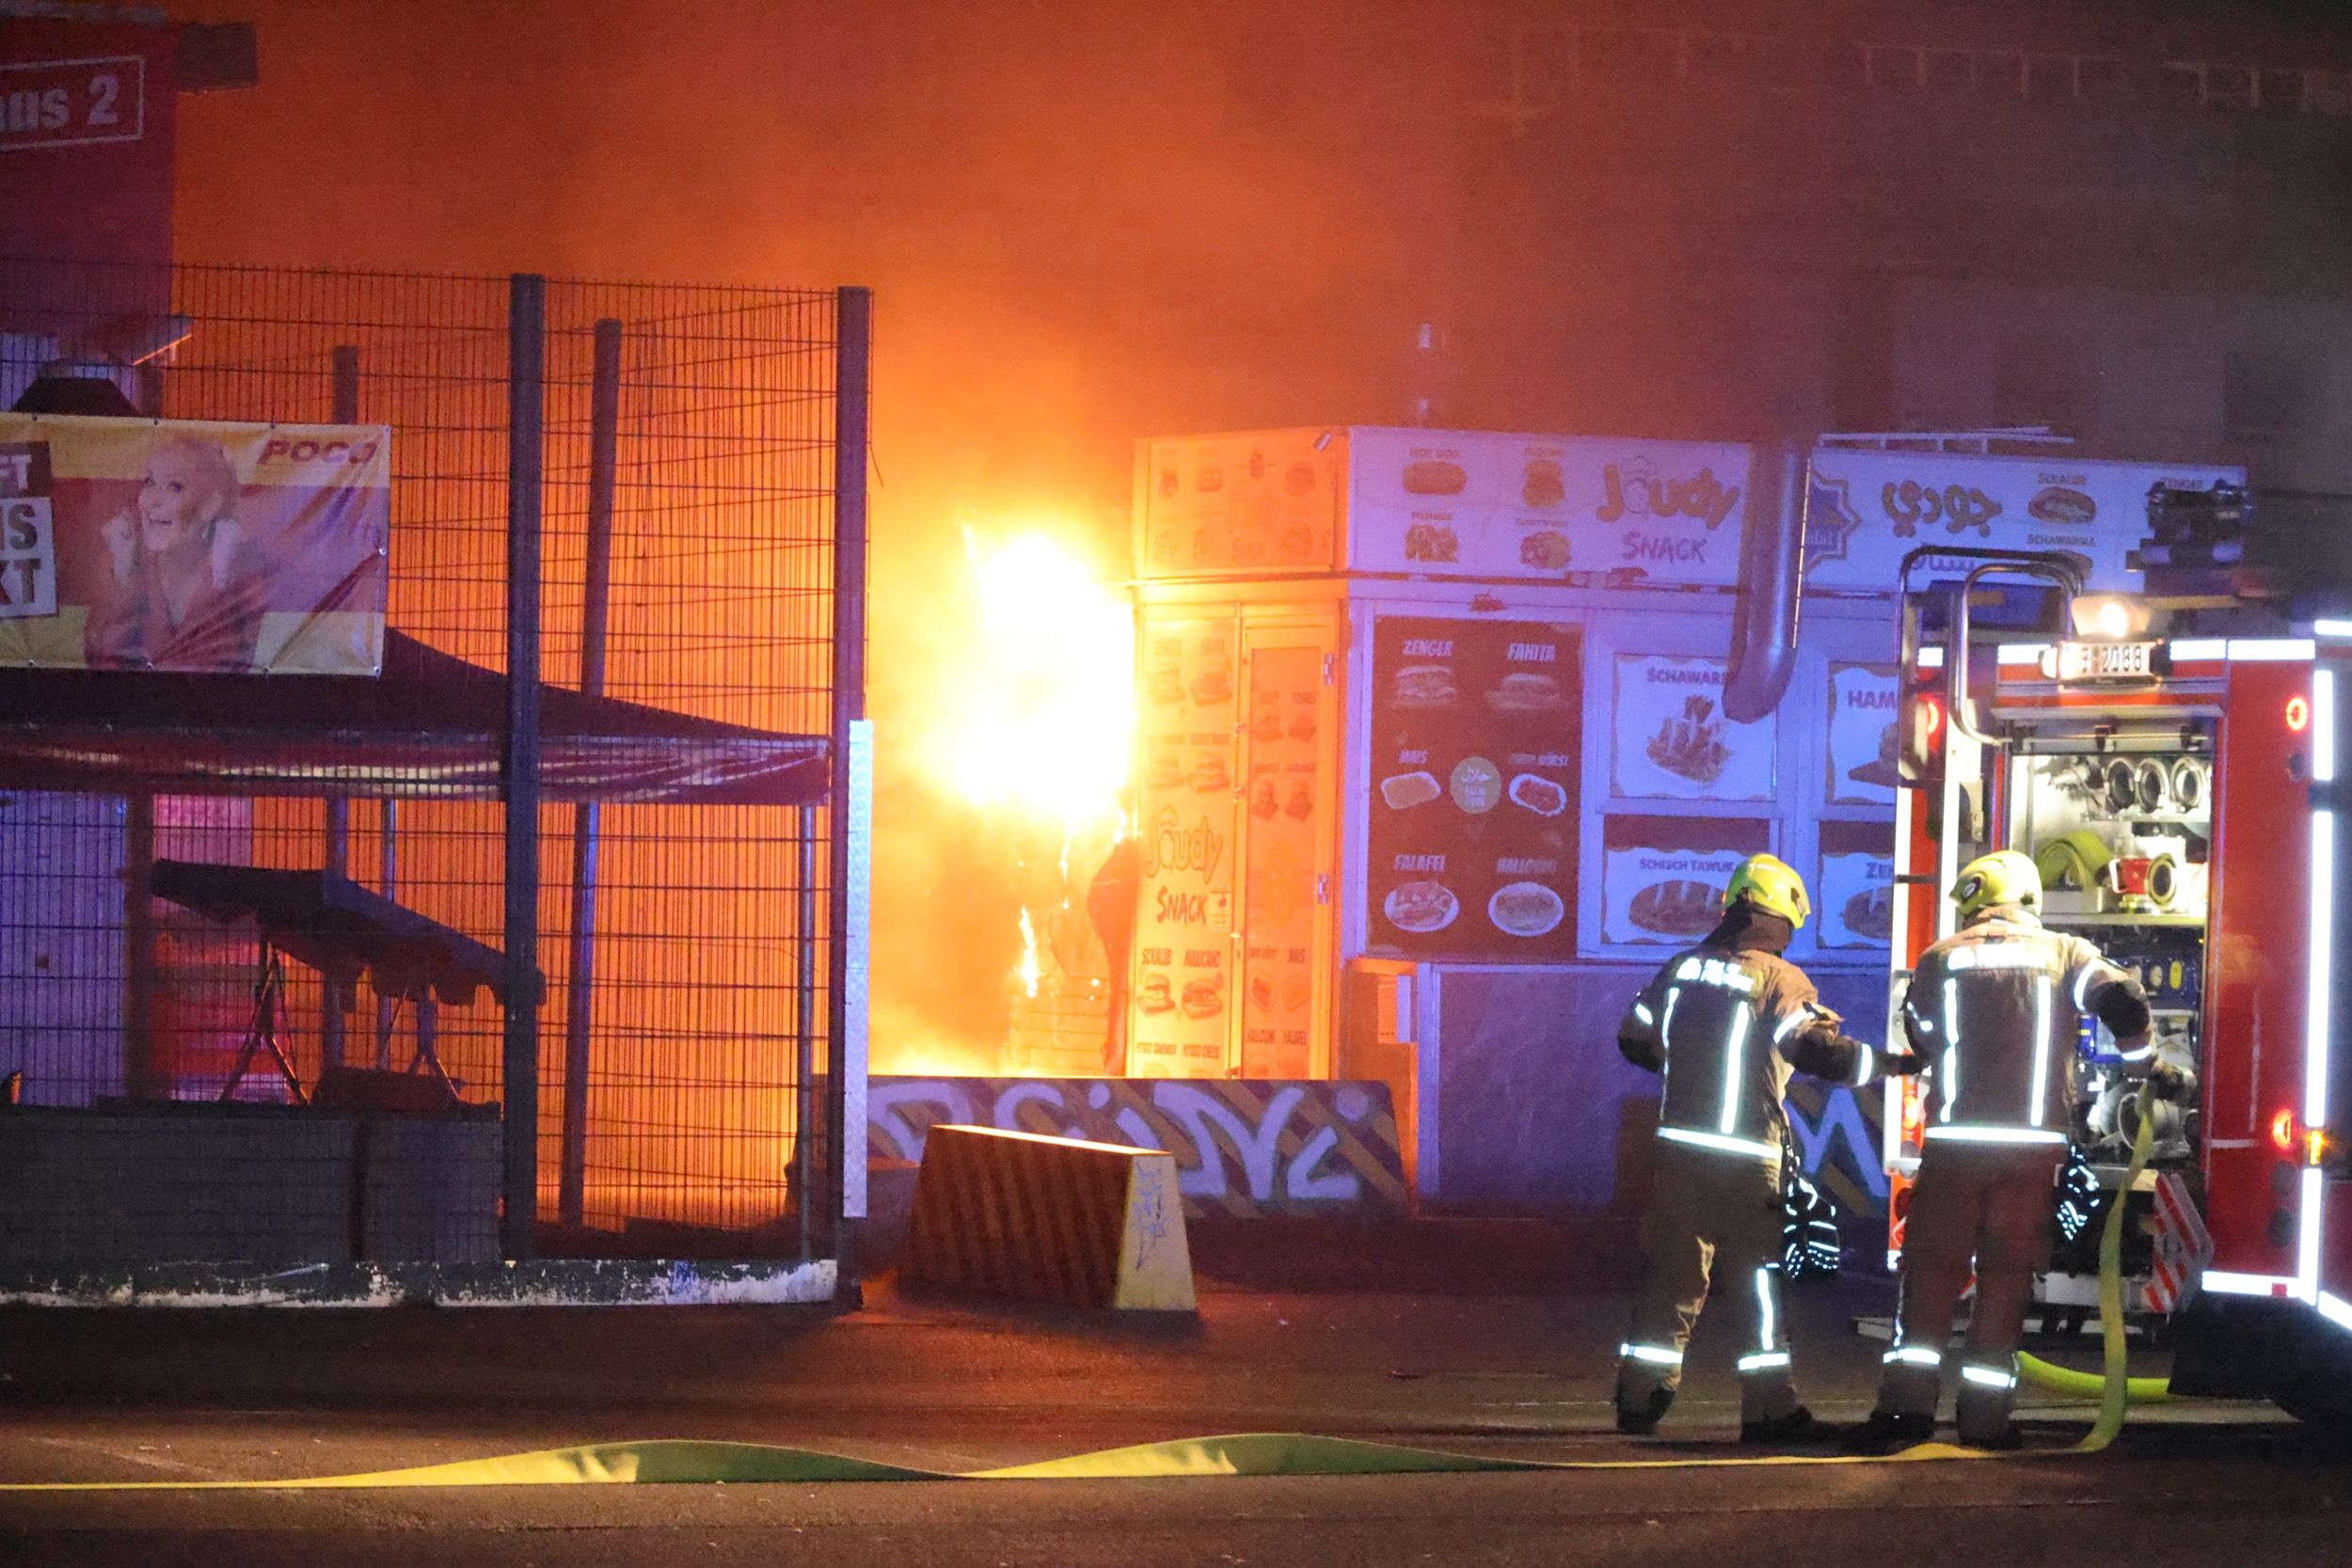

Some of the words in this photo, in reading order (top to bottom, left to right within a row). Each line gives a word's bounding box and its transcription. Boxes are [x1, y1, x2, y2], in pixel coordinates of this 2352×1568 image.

[0, 88, 70, 133] us
[87, 75, 120, 124] 2
[257, 439, 378, 466] POCO
[1622, 531, 1708, 562] SNACK
[1639, 858, 1688, 872] SCHISCH
[1690, 859, 1735, 873] TAWUK
[1156, 886, 1208, 927] SNACK
